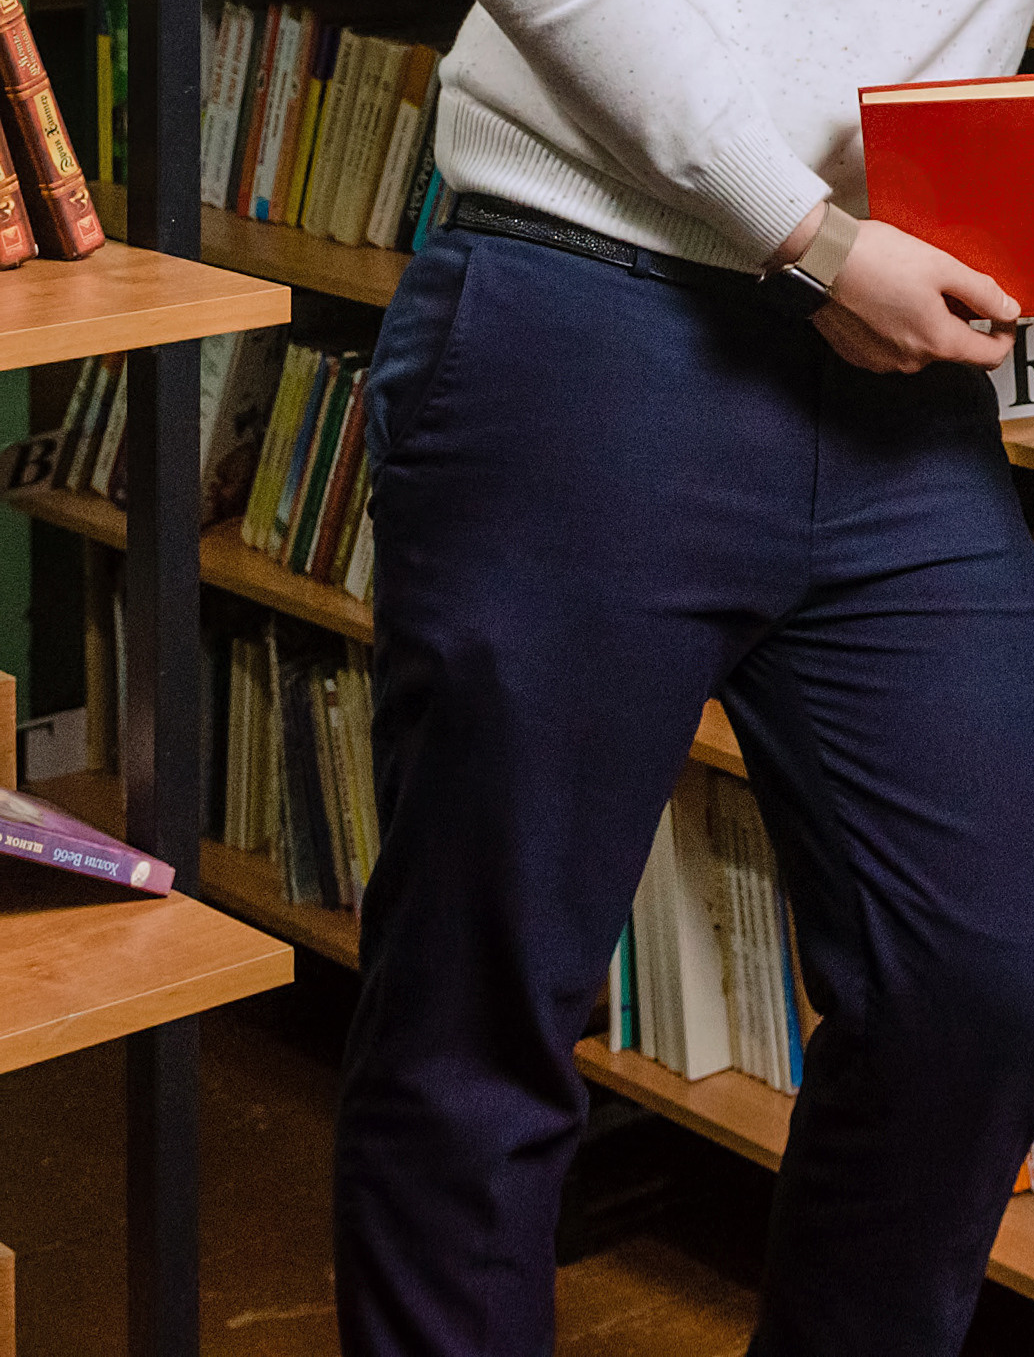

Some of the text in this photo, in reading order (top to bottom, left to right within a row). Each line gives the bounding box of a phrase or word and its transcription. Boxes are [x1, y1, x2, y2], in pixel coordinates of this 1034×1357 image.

[4, 835, 120, 876] Холли Вебб ЩЕНОК
